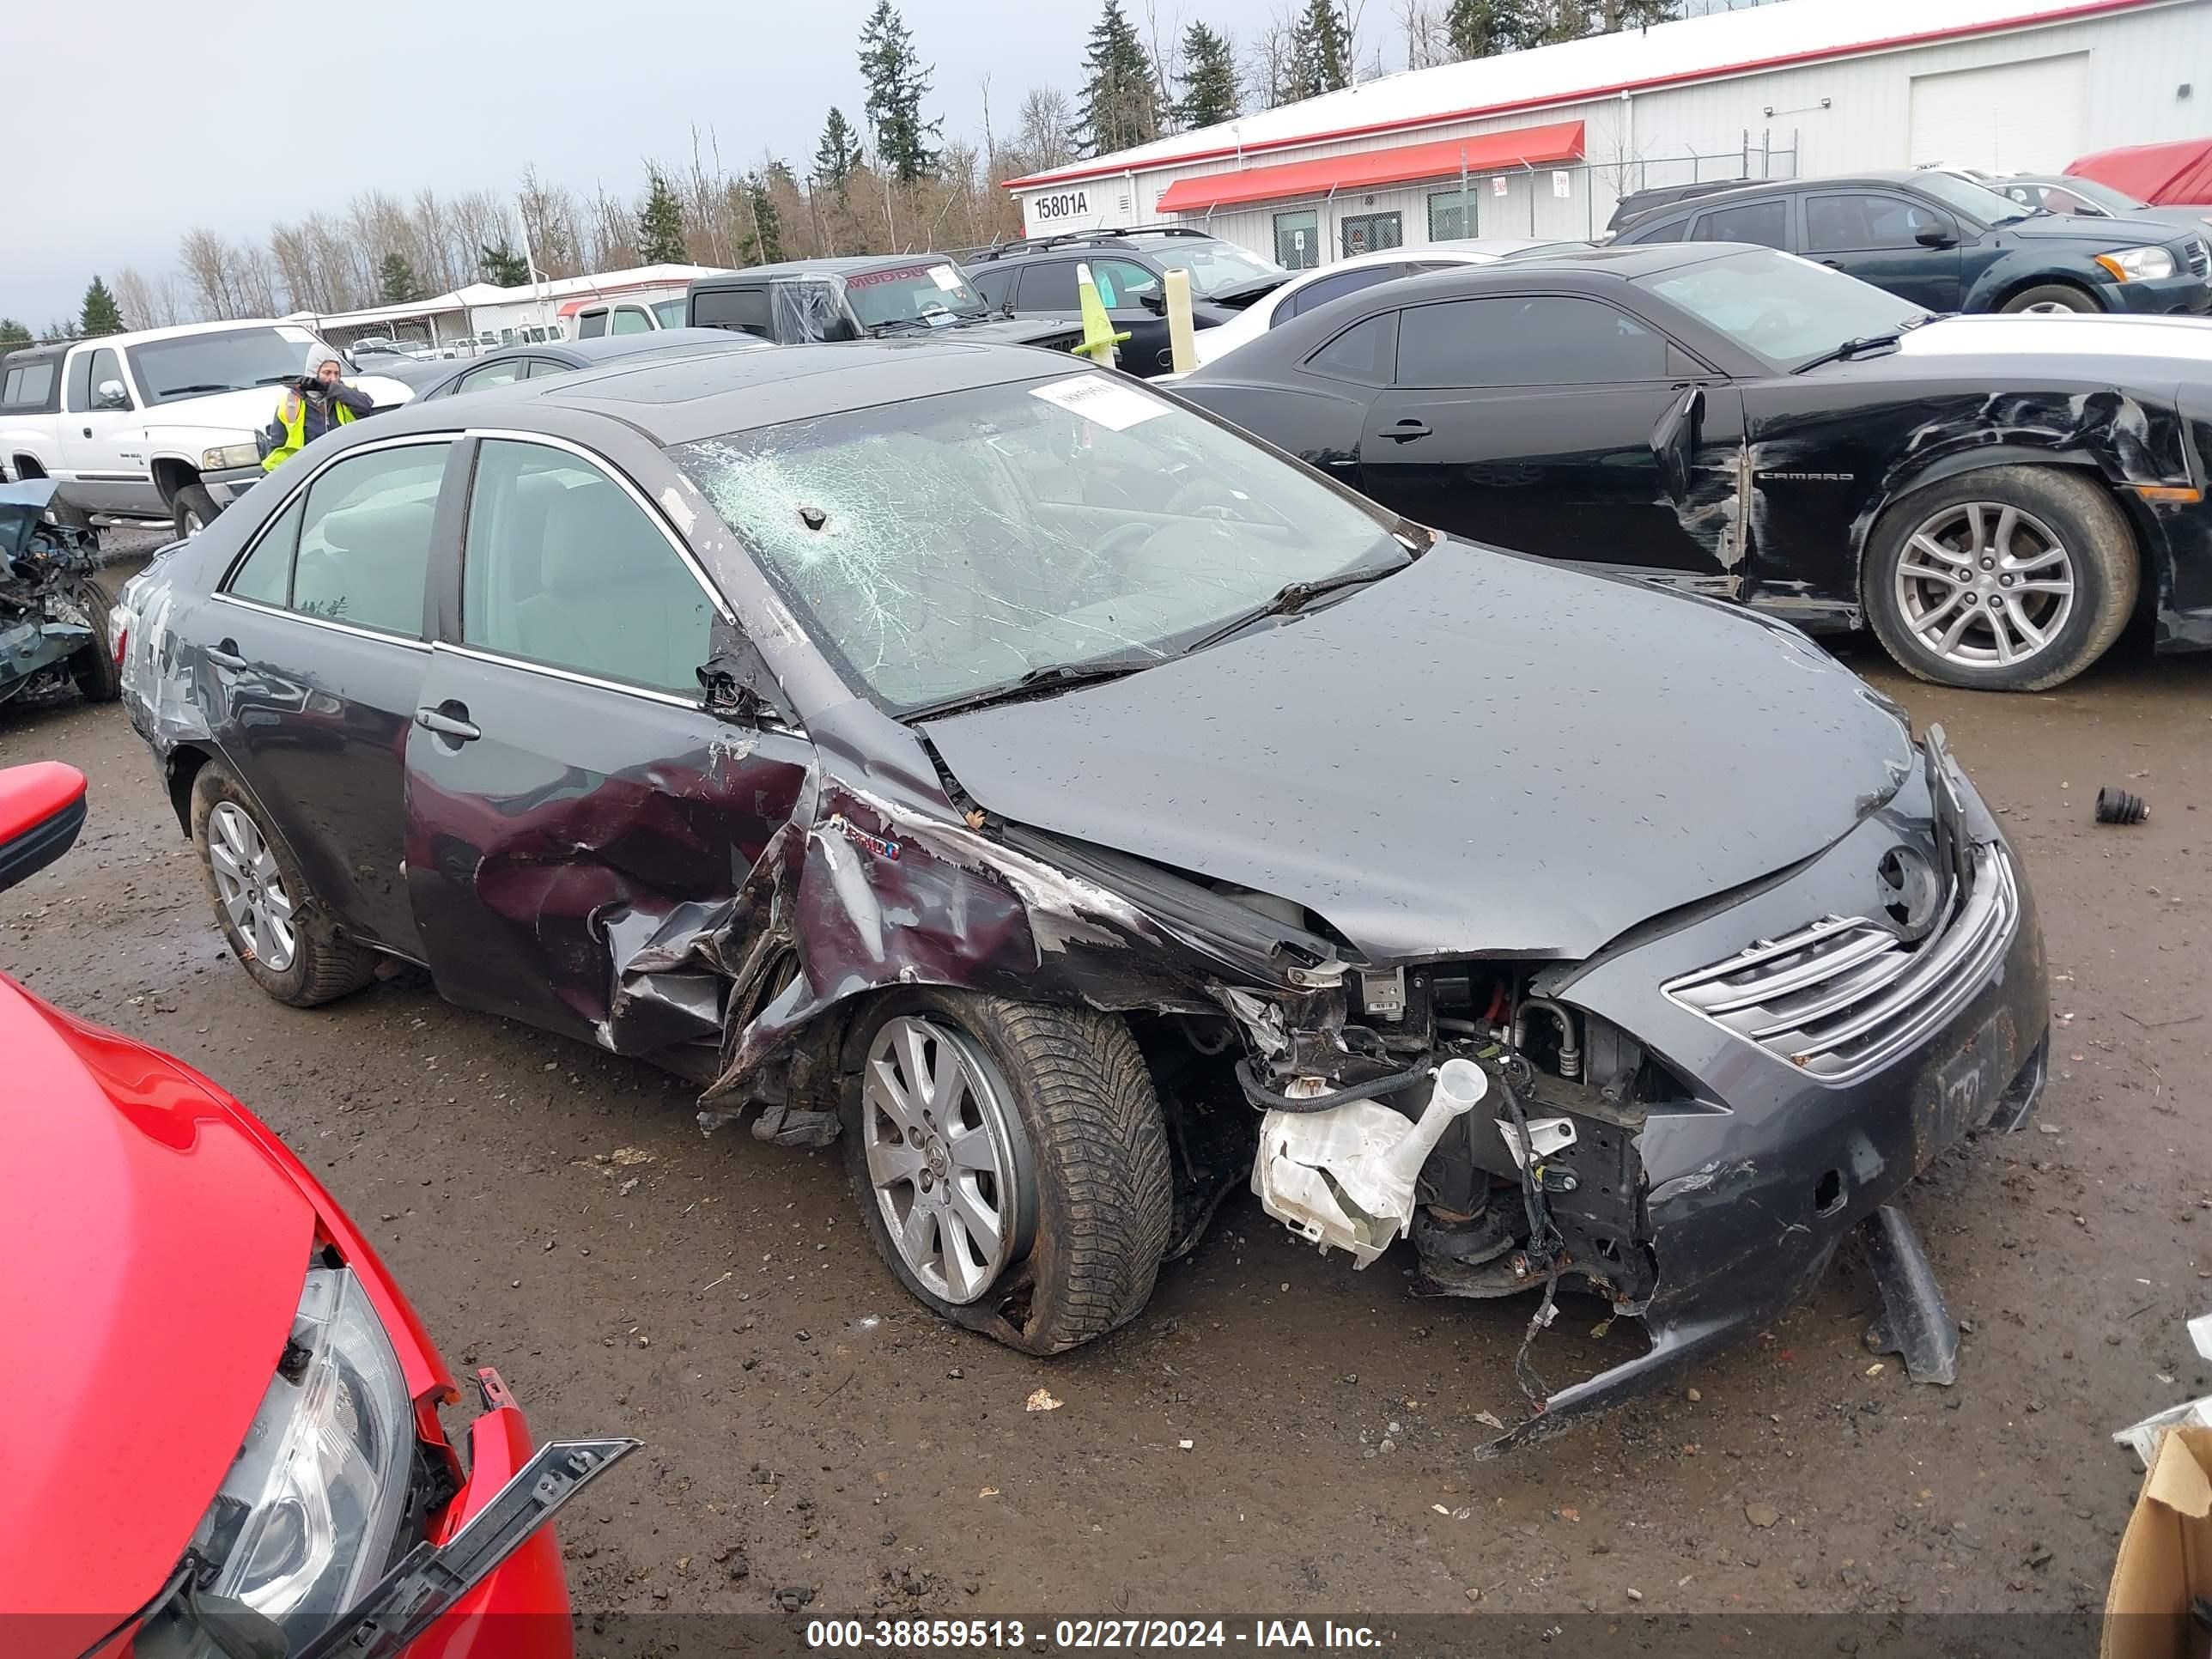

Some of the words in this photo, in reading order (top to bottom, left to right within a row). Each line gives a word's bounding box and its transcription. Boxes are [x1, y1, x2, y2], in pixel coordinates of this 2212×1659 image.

[1035, 191, 1088, 219] 15801A
[848, 266, 929, 289] MUDDU
[1758, 472, 1855, 481] CAMARO
